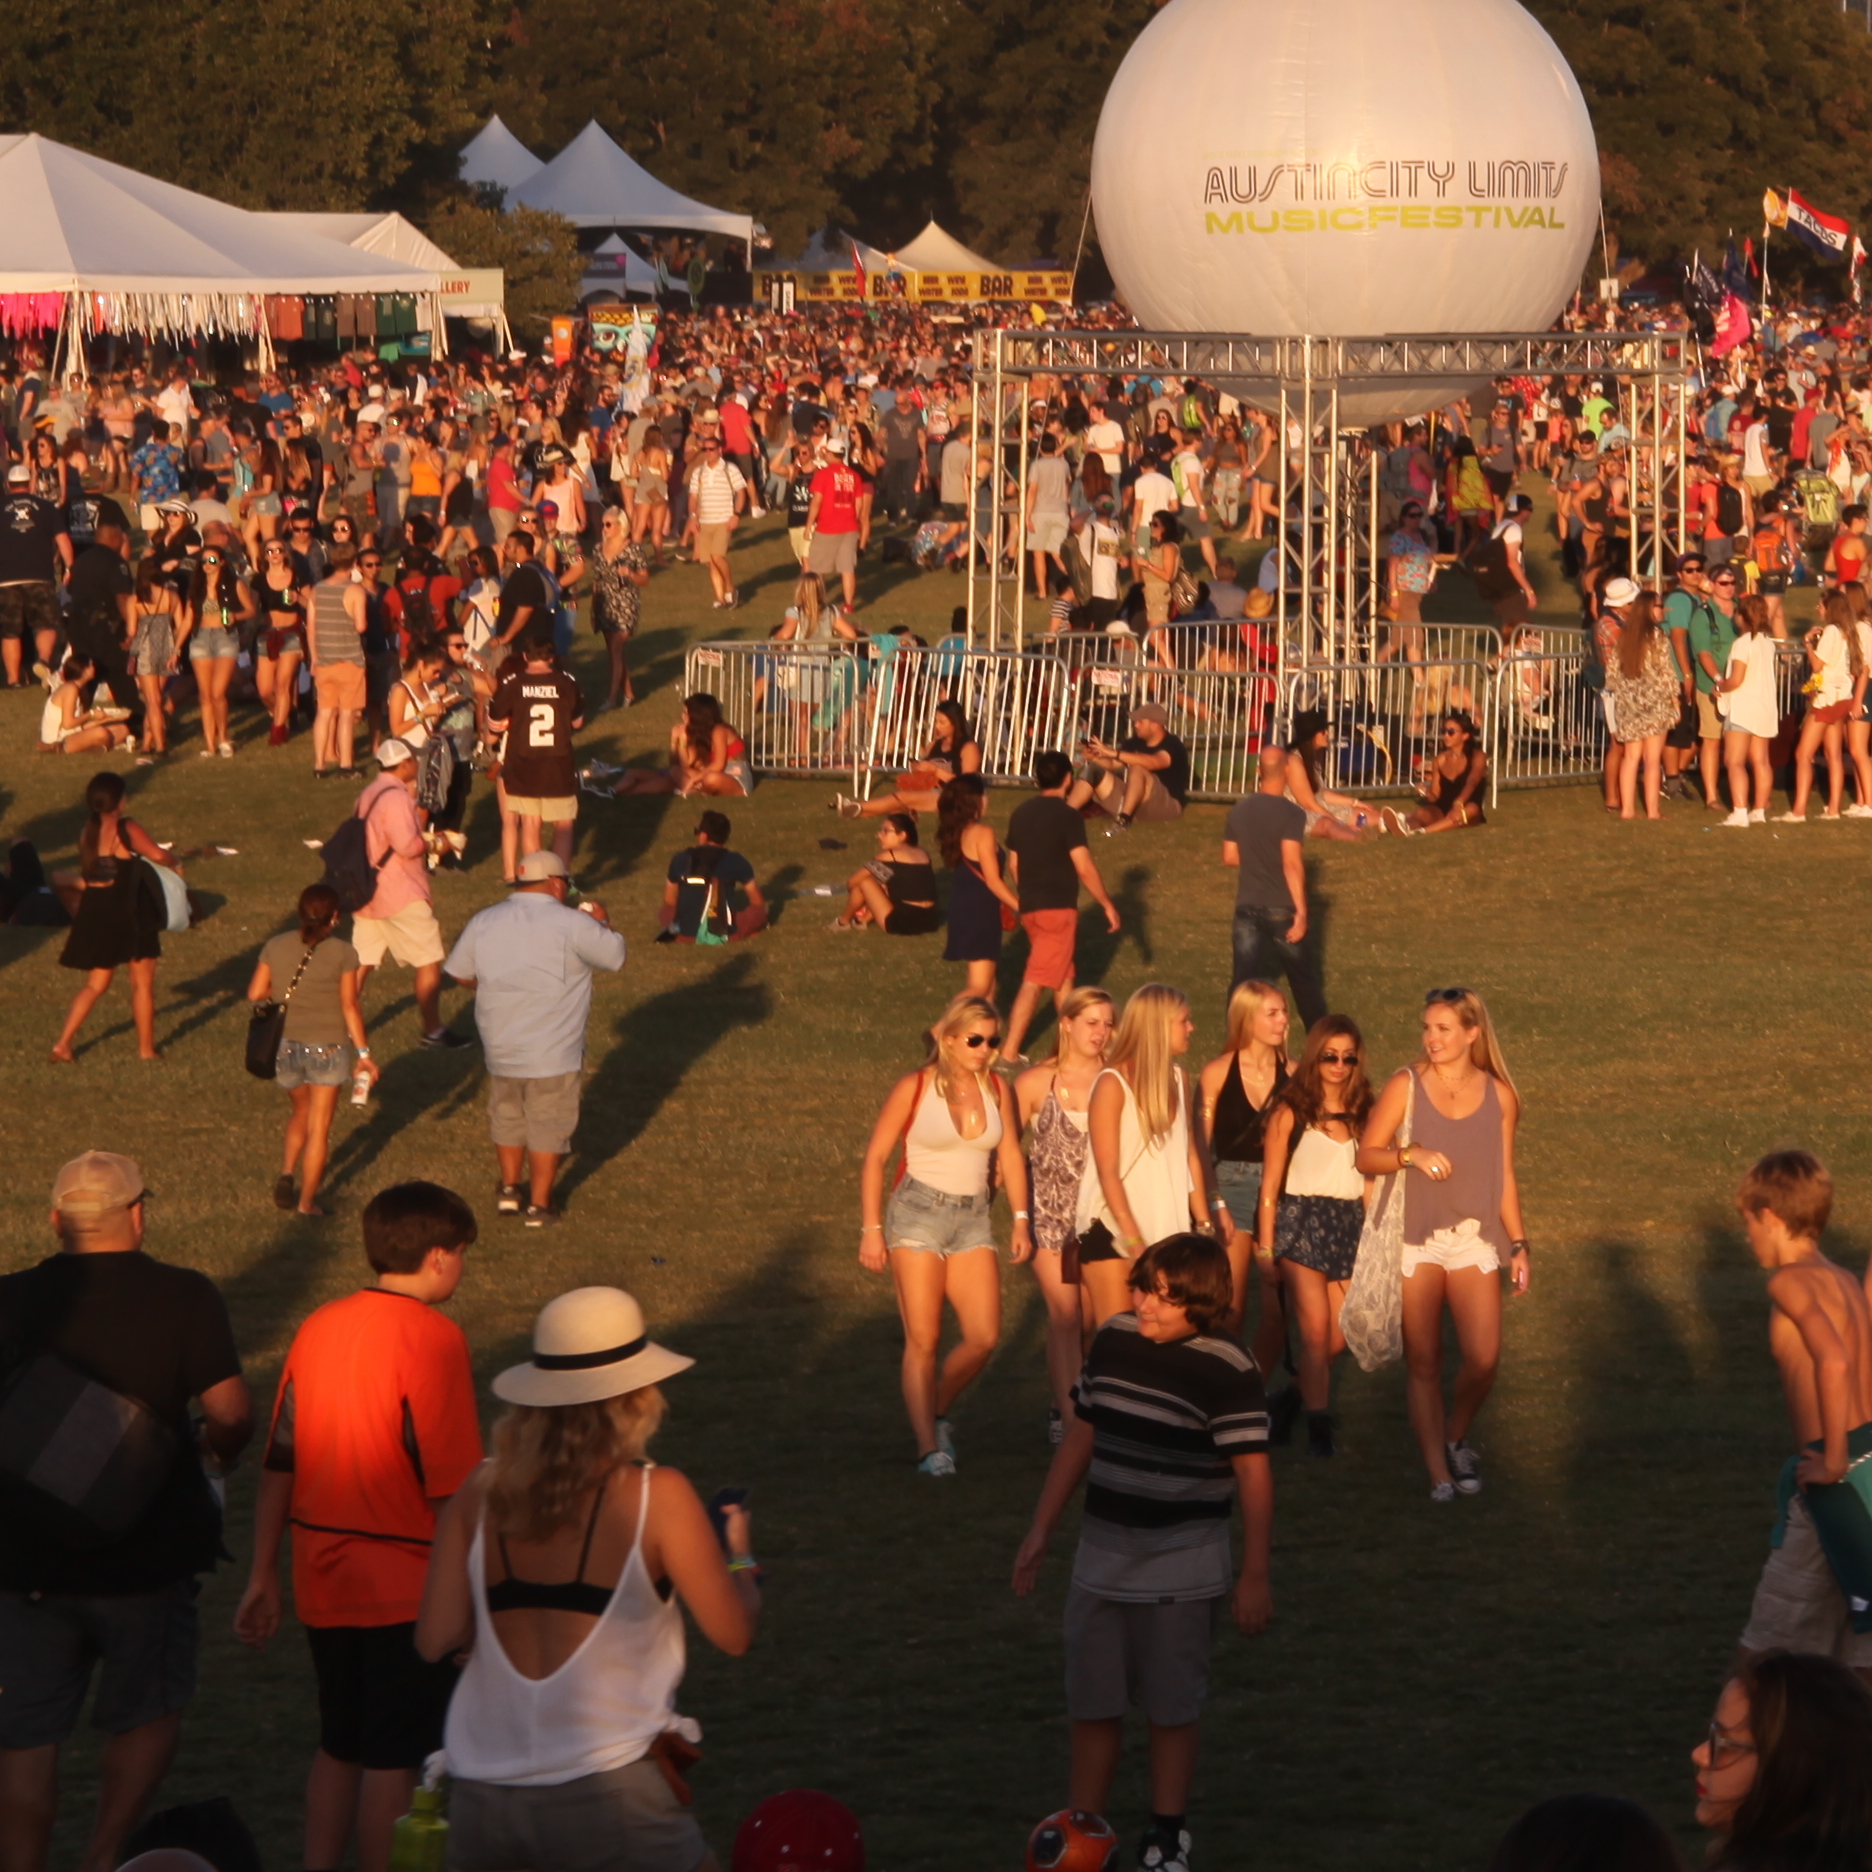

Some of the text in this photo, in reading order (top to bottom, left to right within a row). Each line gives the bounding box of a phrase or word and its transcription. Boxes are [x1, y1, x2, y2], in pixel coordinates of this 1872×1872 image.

[1468, 159, 1569, 200] LIMITS
[1796, 207, 1840, 247] TACOS
[873, 274, 907, 296] BR
[980, 275, 1013, 296] BAR
[522, 685, 560, 699] MANZIEL
[529, 704, 555, 747] 2
